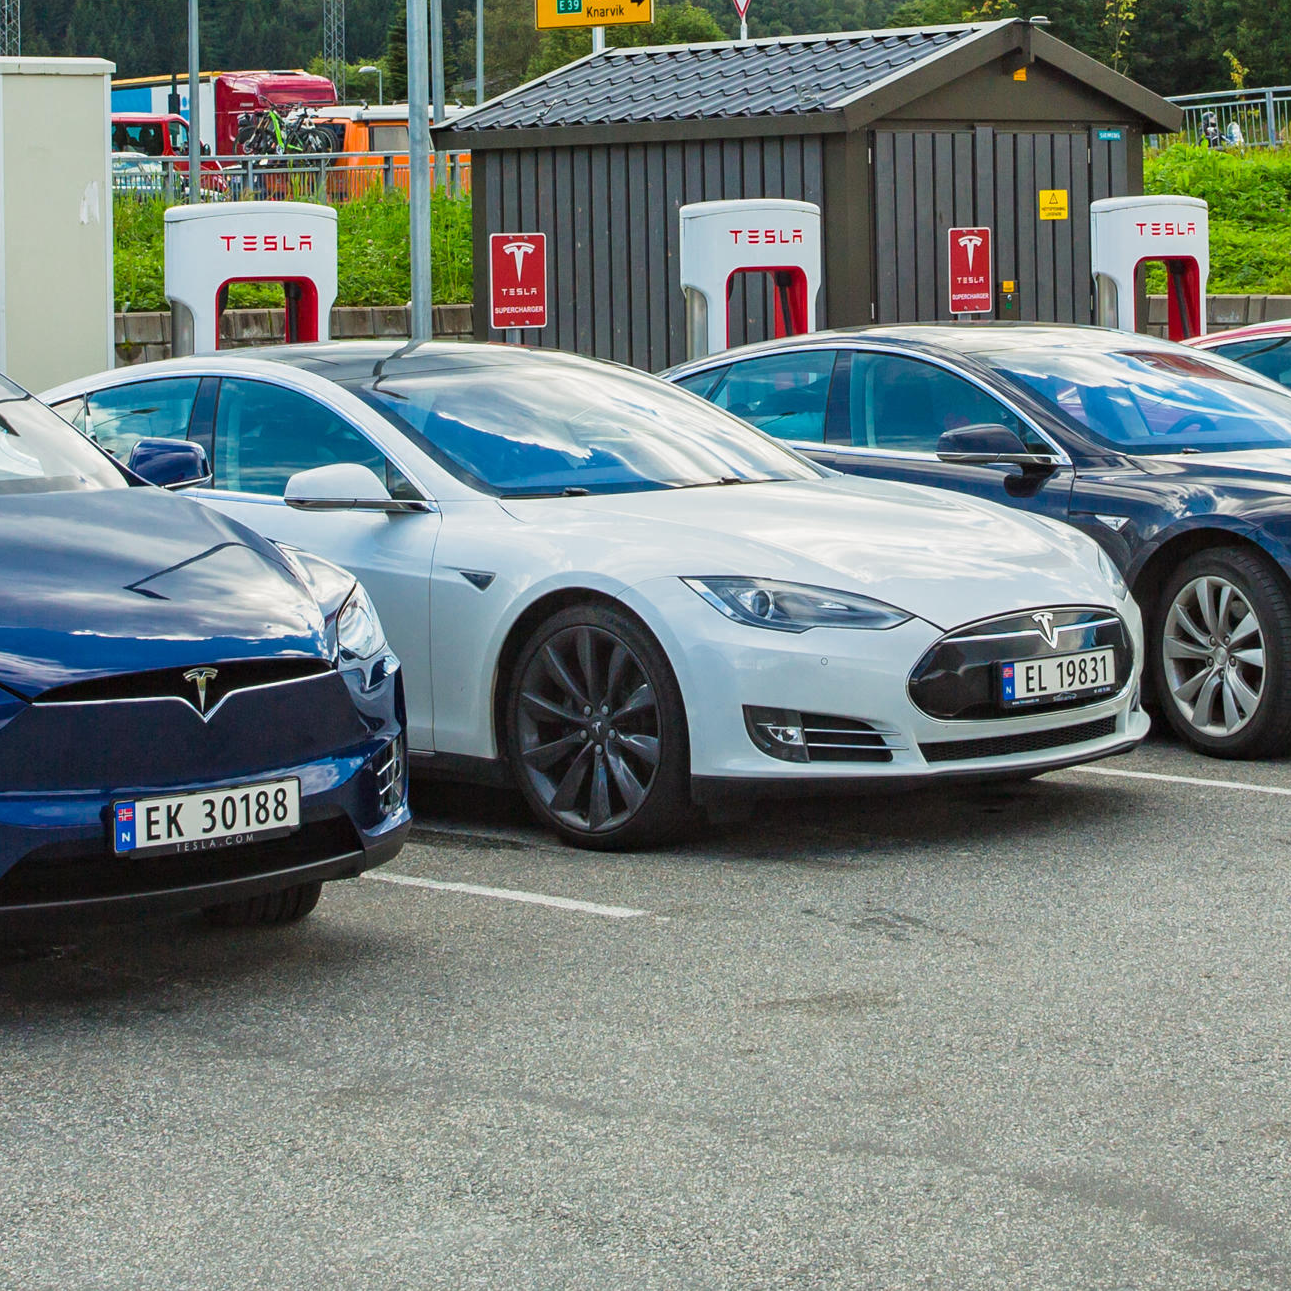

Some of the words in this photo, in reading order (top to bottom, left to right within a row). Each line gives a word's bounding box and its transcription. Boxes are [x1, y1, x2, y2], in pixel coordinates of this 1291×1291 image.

[587, 5, 624, 18] Knarvik
[1135, 222, 1196, 236] TESLA
[219, 235, 312, 251] TESLA
[729, 229, 802, 244] TESLA
[957, 276, 984, 284] TESLA
[501, 288, 537, 296] TESLA
[494, 305, 544, 314] SUPERCHARGER
[1026, 665, 1047, 693] EL
[1056, 655, 1107, 688] 19831
[1006, 686, 1012, 694] N
[146, 803, 184, 842] EK
[201, 787, 288, 833] 30188
[122, 832, 130, 842] N
